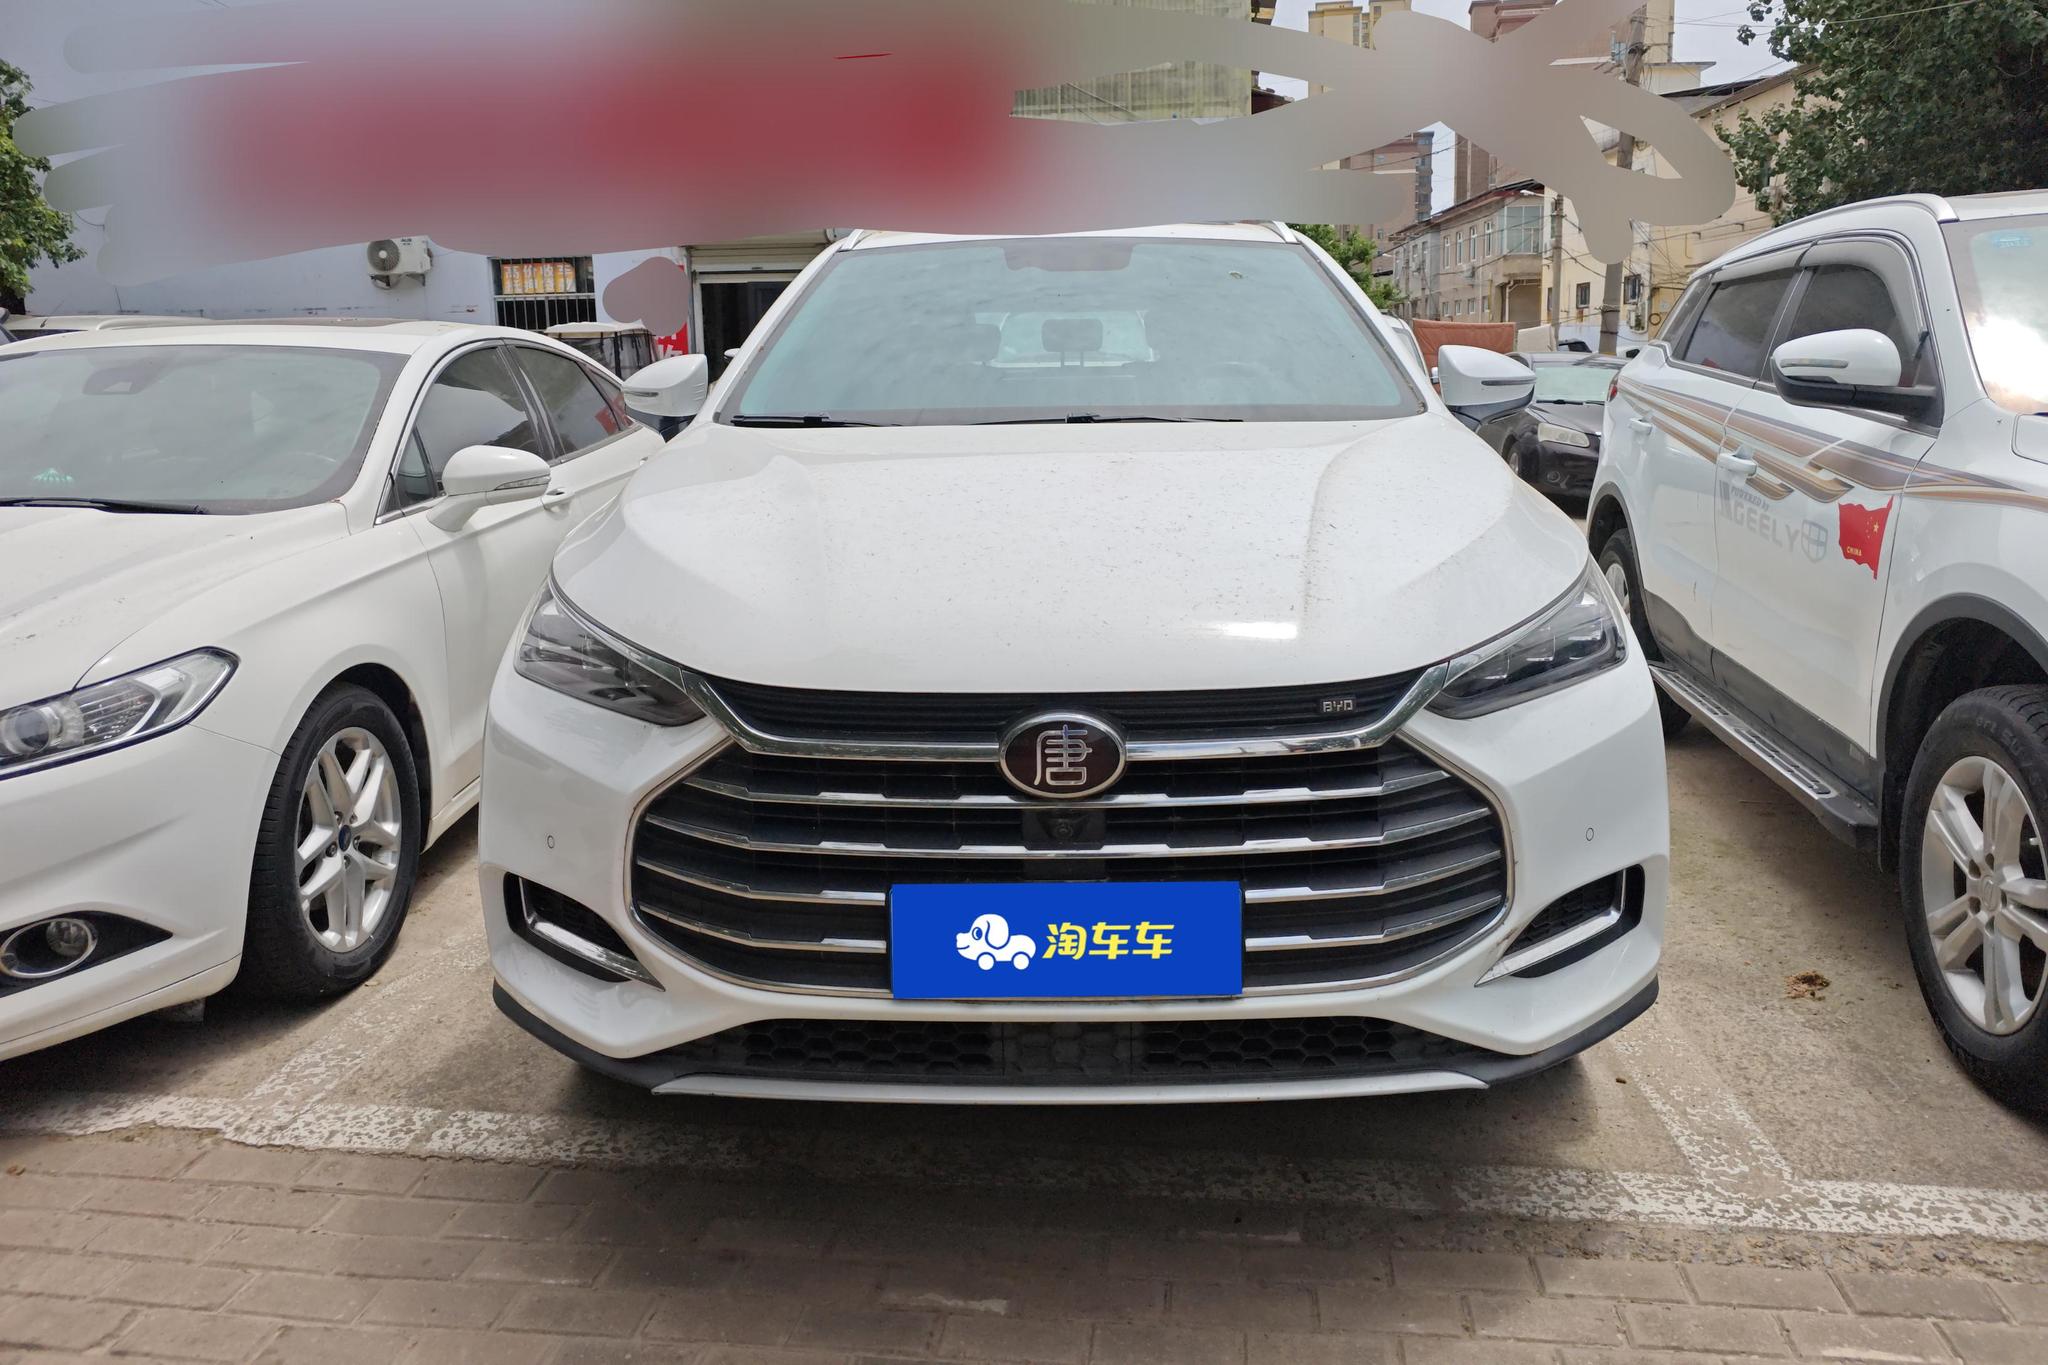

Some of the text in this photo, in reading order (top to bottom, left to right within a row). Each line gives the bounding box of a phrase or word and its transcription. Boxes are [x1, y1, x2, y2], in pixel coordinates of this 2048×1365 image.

[1733, 500, 1800, 552] GEELY
[1846, 546, 1862, 557] CHINA
[1323, 700, 1353, 712] BYD
[1033, 724, 1093, 786] 唐
